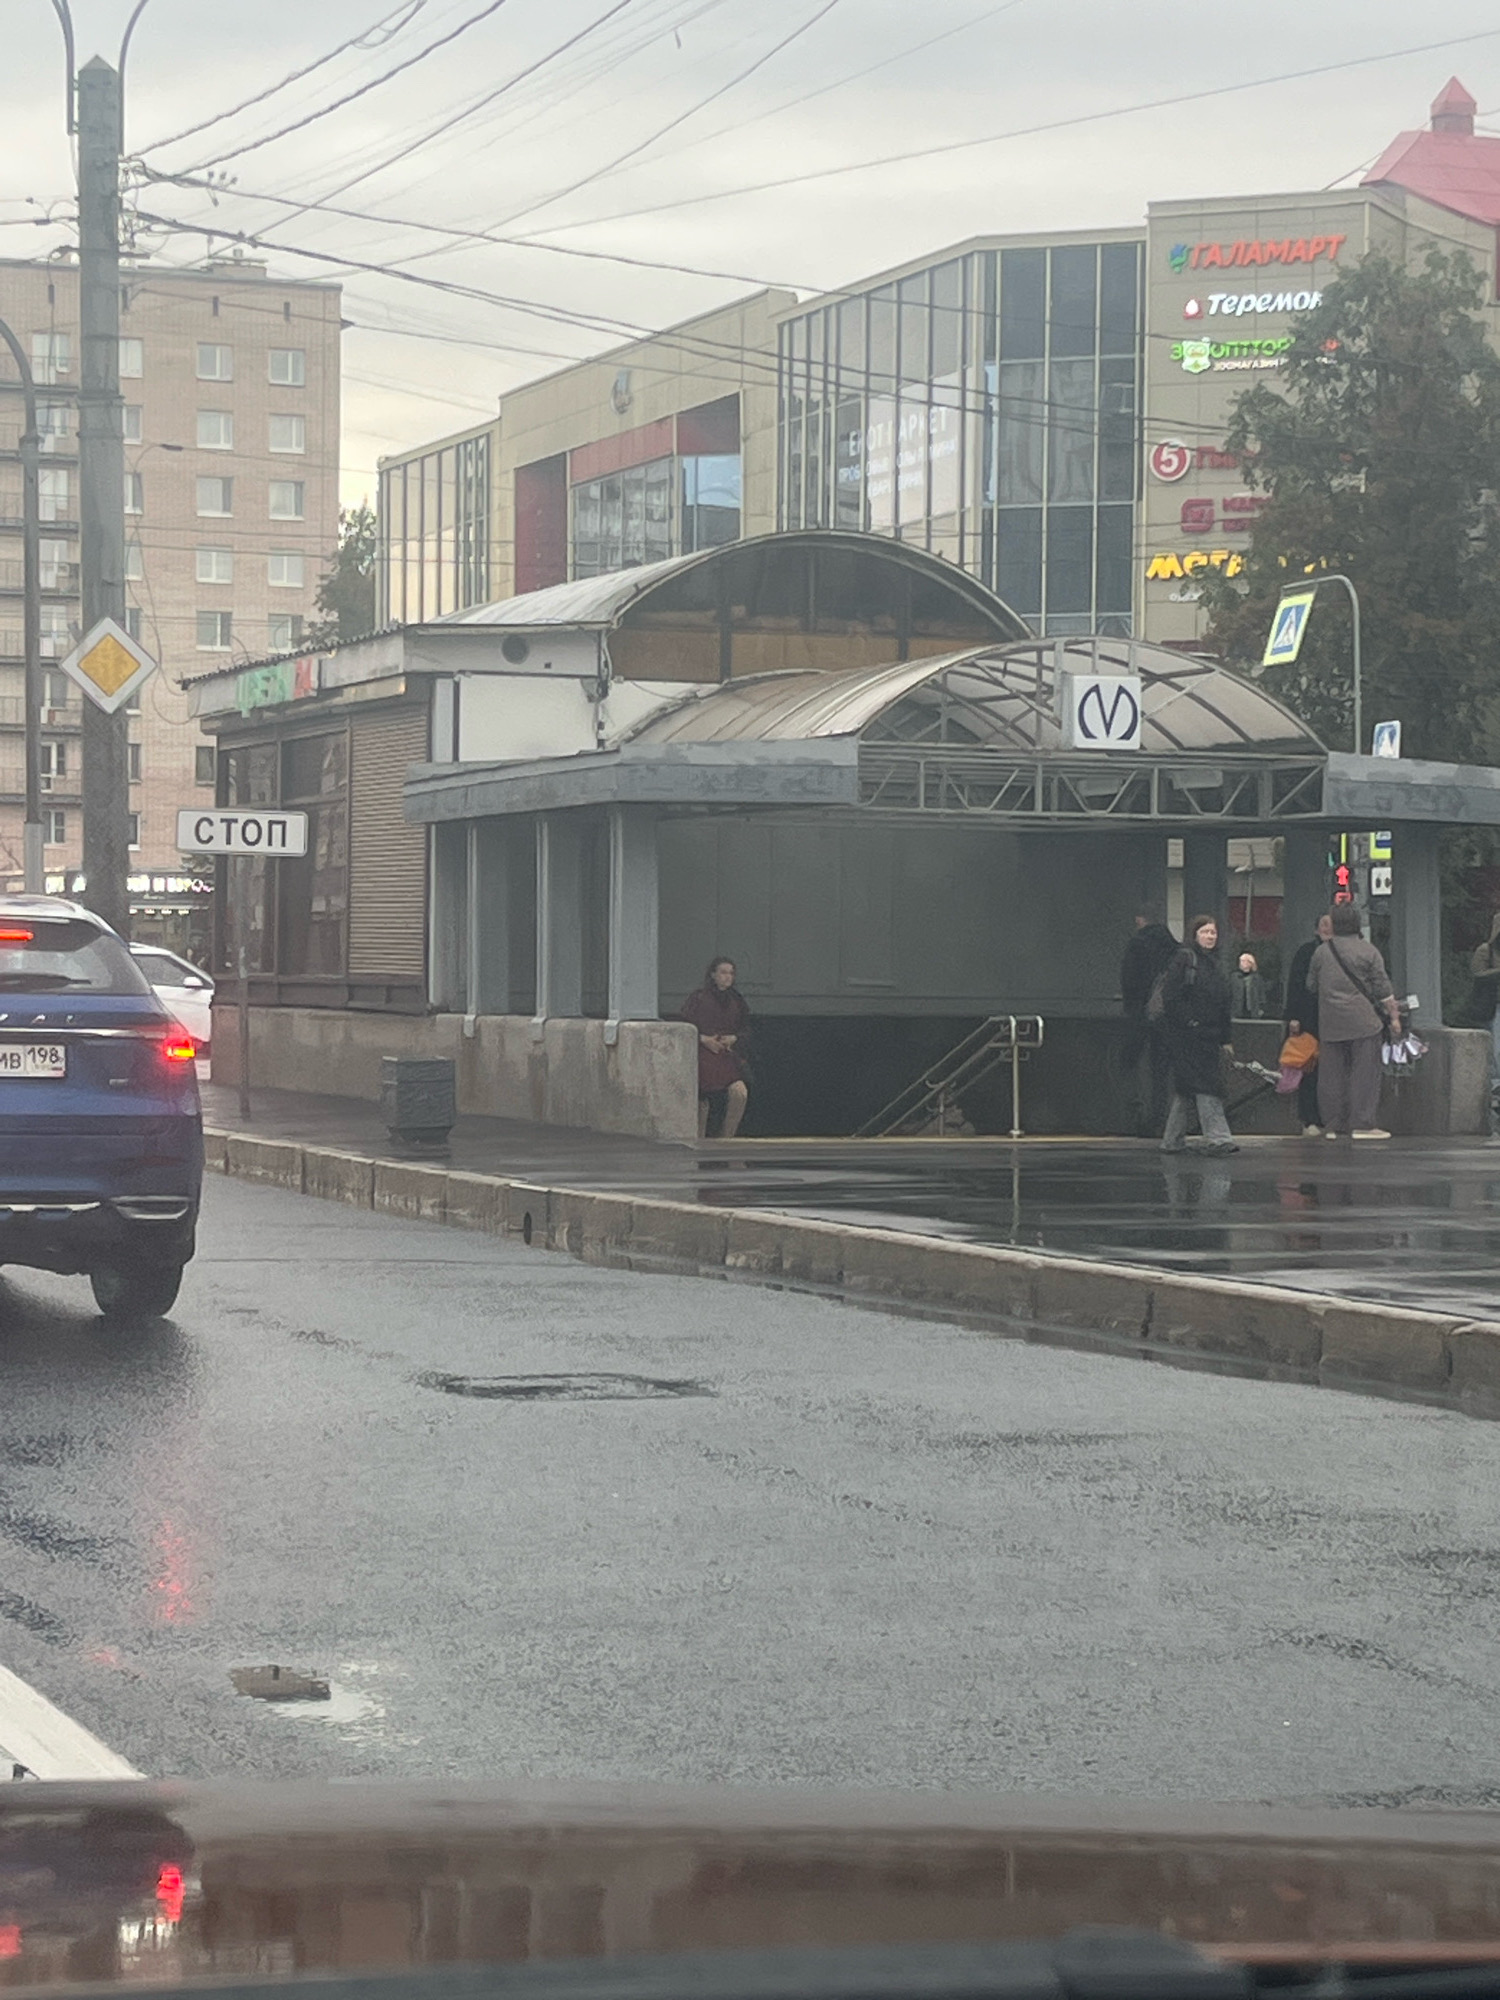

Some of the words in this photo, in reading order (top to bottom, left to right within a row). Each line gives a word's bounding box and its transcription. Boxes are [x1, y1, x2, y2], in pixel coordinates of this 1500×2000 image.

[1190, 235, 1347, 270] ГАЛАМАРТ
[194, 817, 287, 848] СТОП
[28, 1047, 59, 1064] 198
